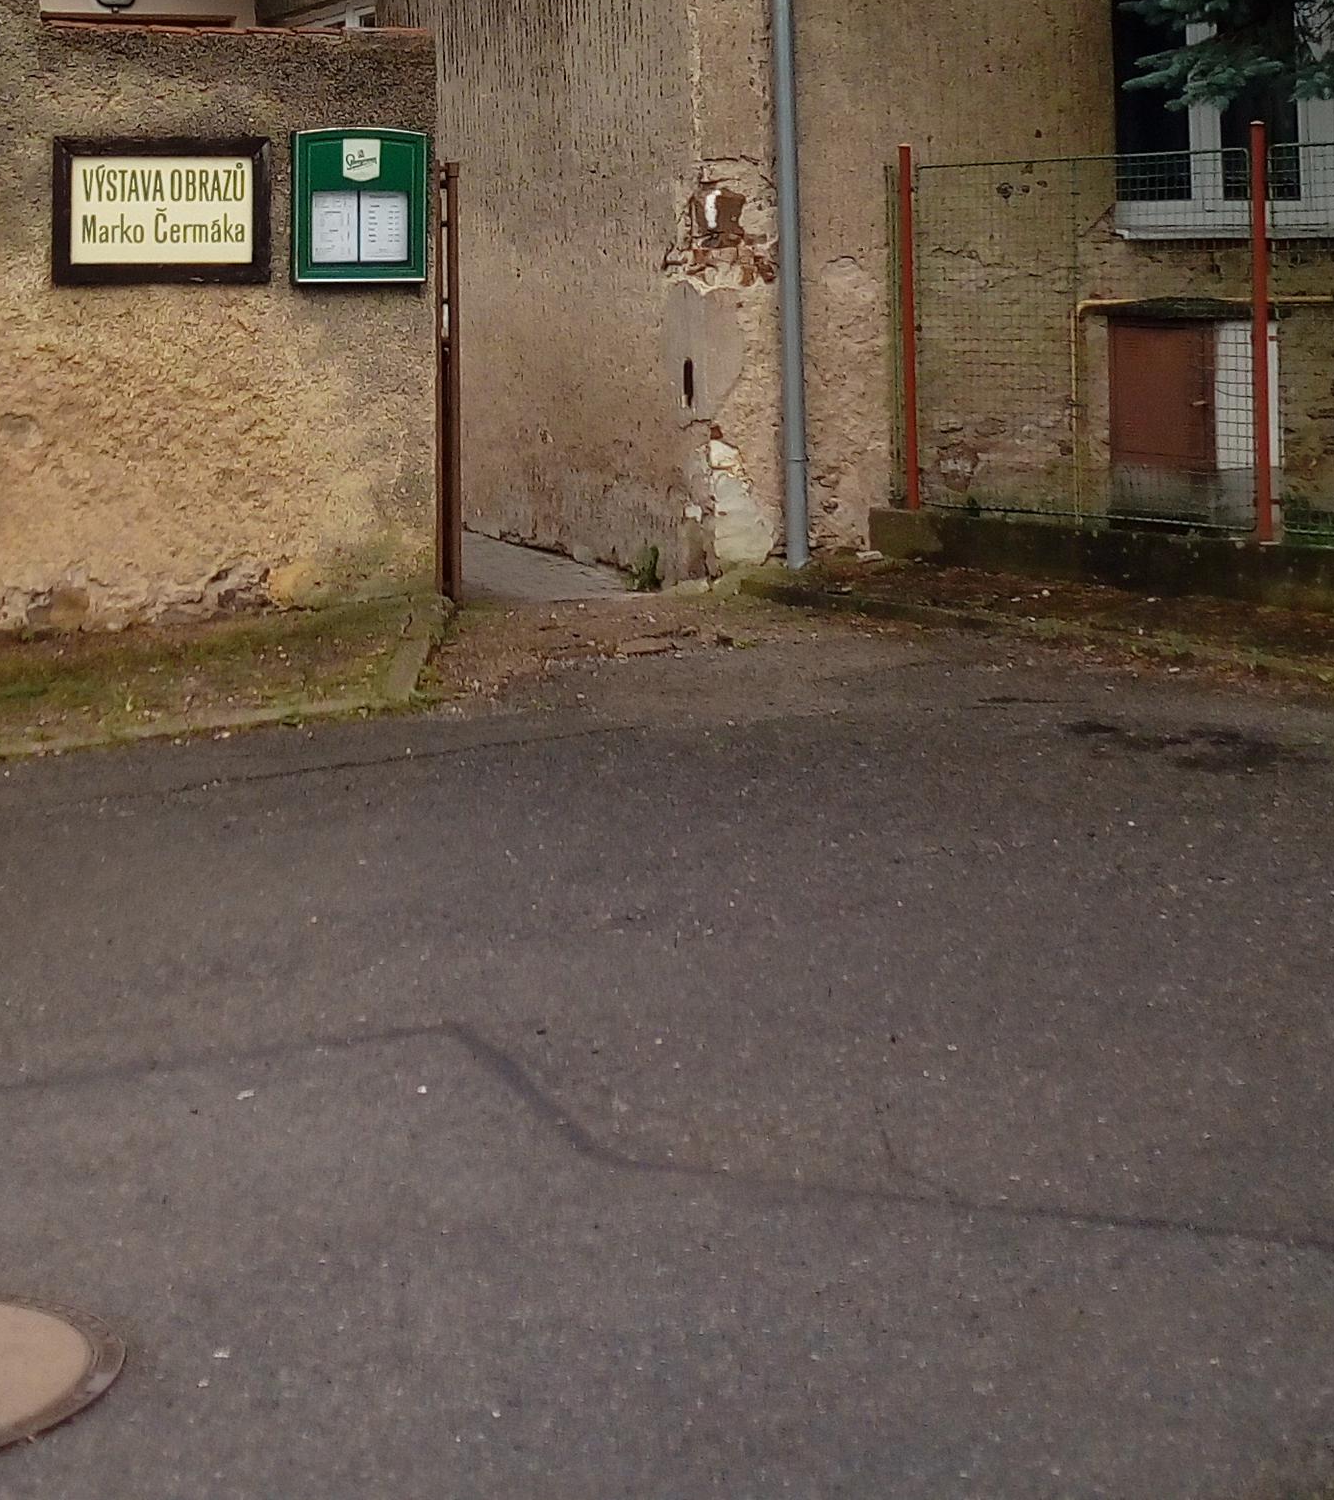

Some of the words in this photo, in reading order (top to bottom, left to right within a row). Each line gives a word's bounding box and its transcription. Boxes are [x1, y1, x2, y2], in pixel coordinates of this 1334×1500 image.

[82, 164, 165, 202] VÝSTAVA
[170, 162, 245, 202] OBRAZŮ
[82, 213, 145, 244] Marko
[154, 207, 246, 244] Čermáka
